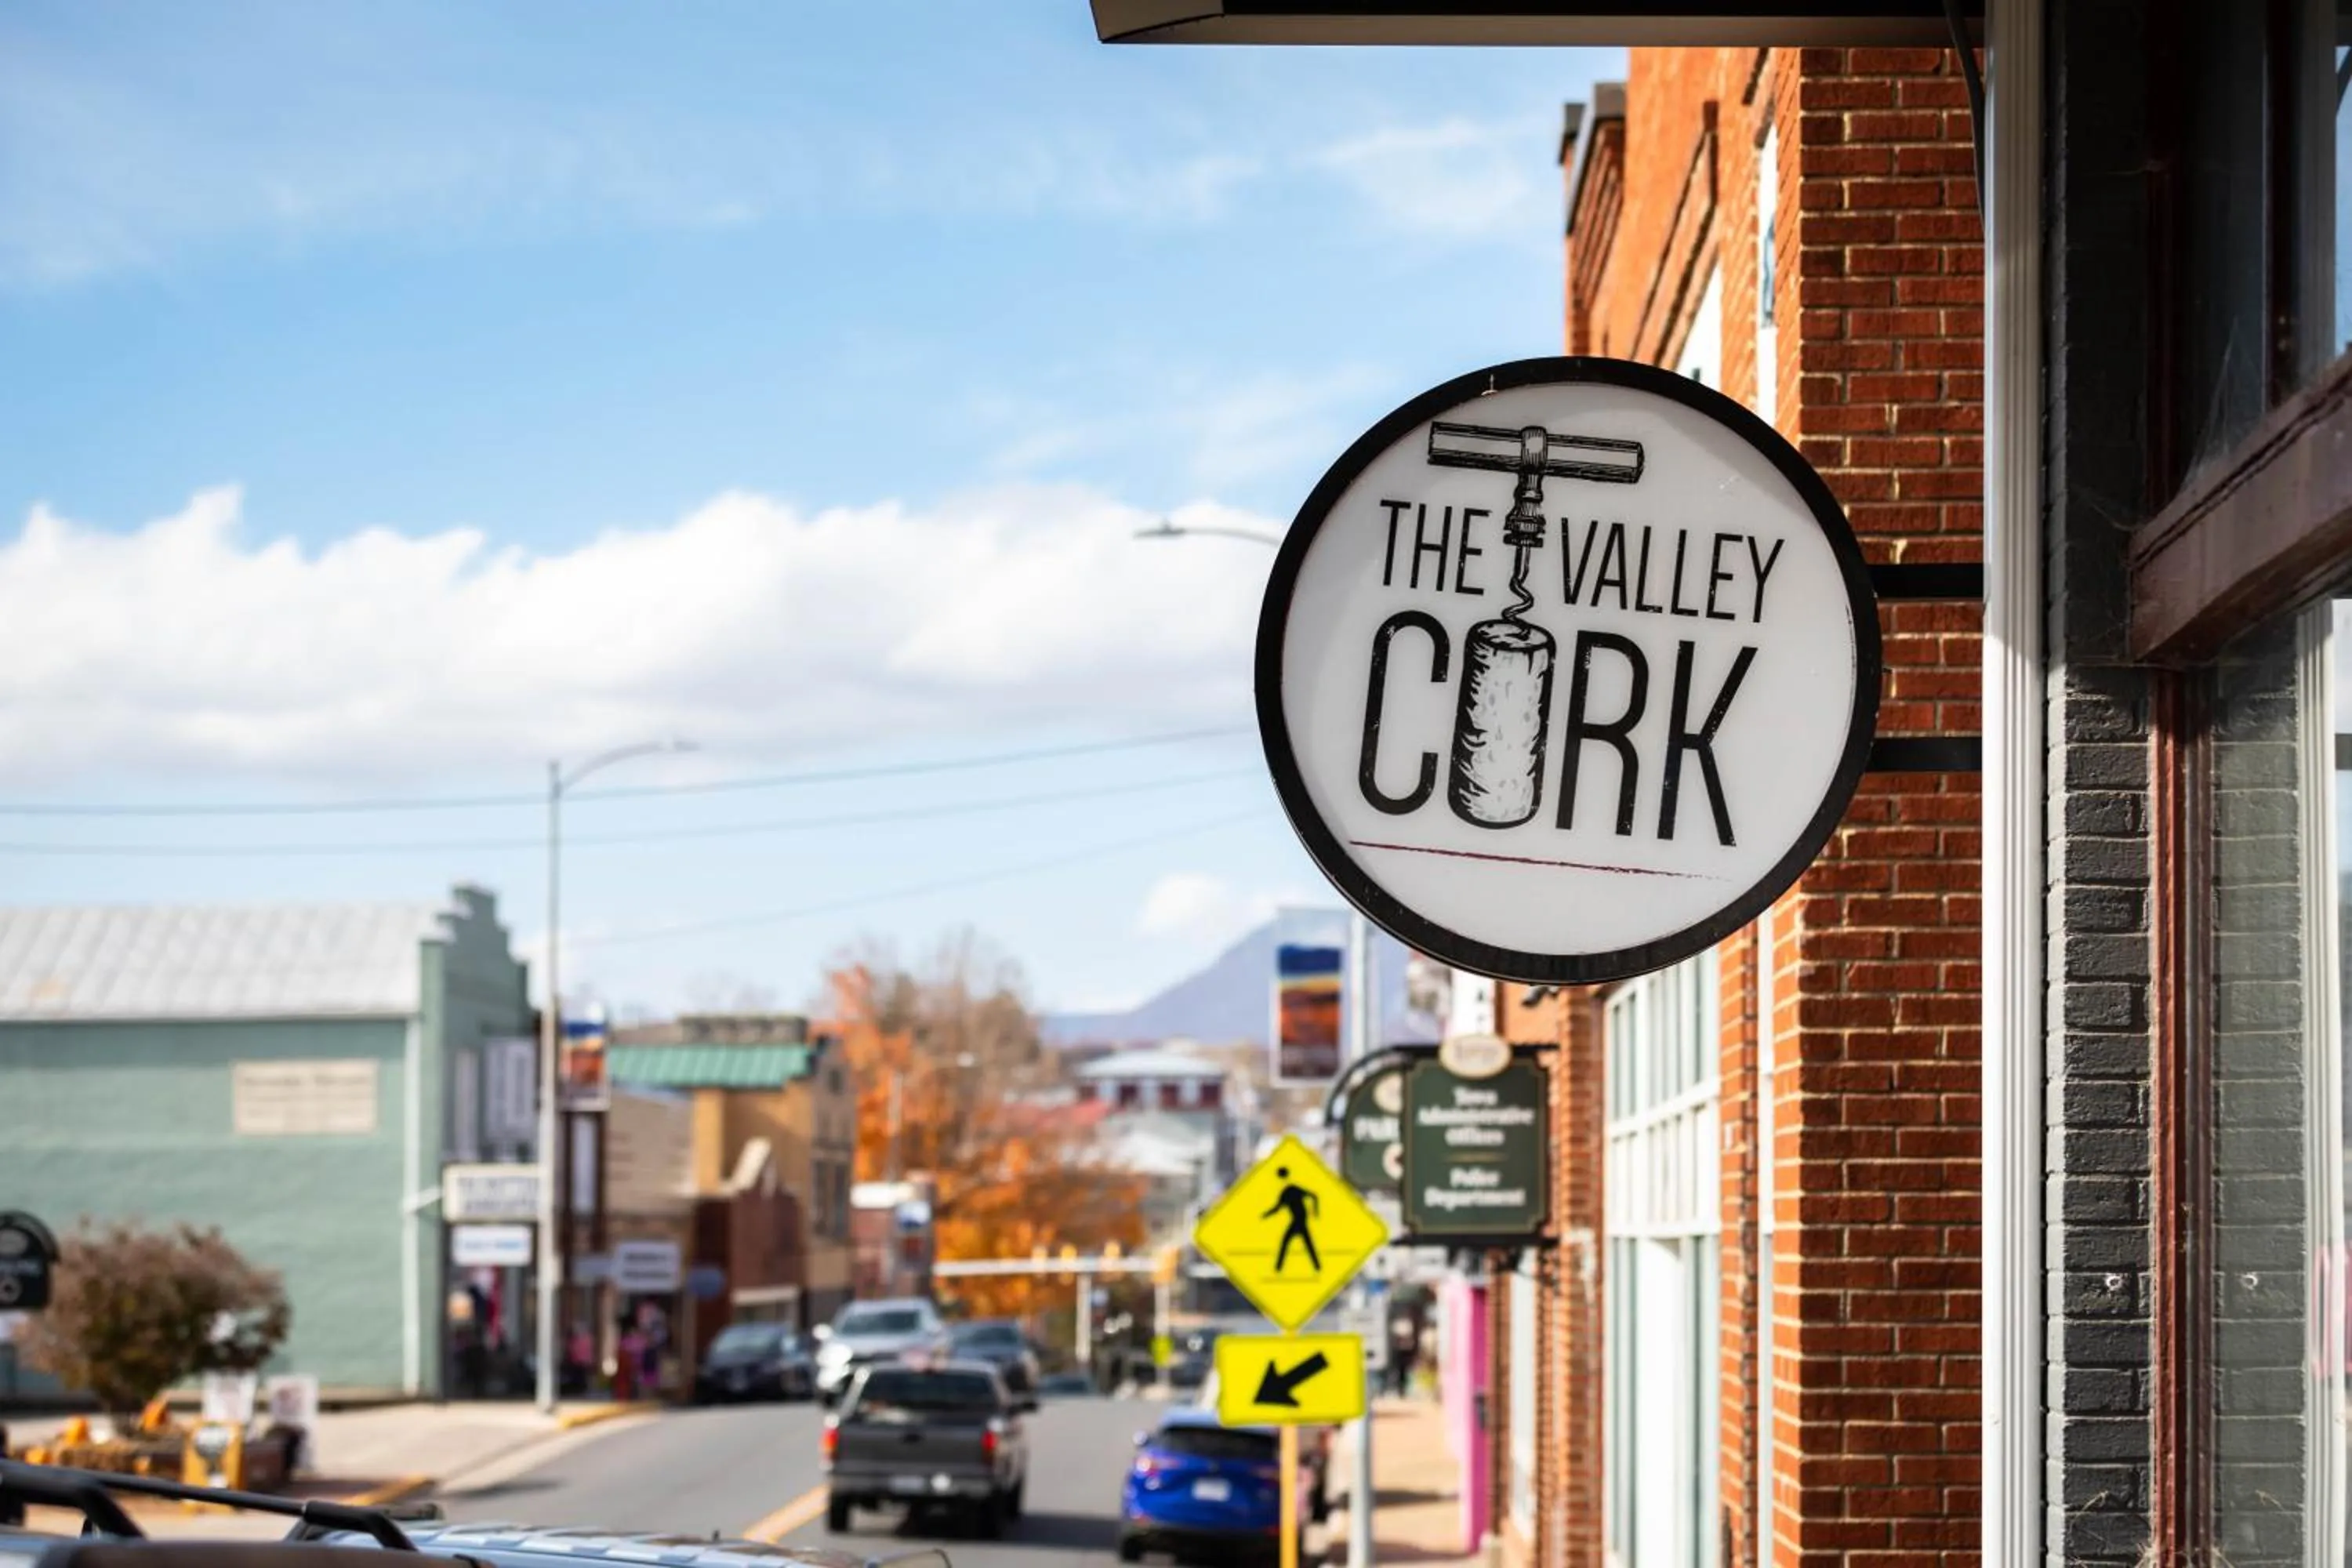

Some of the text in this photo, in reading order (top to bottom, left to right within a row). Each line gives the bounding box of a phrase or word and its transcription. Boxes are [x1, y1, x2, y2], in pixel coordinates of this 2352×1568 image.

[1380, 499, 1785, 622] THE VALLEY
[1359, 610, 1758, 846] CORK
